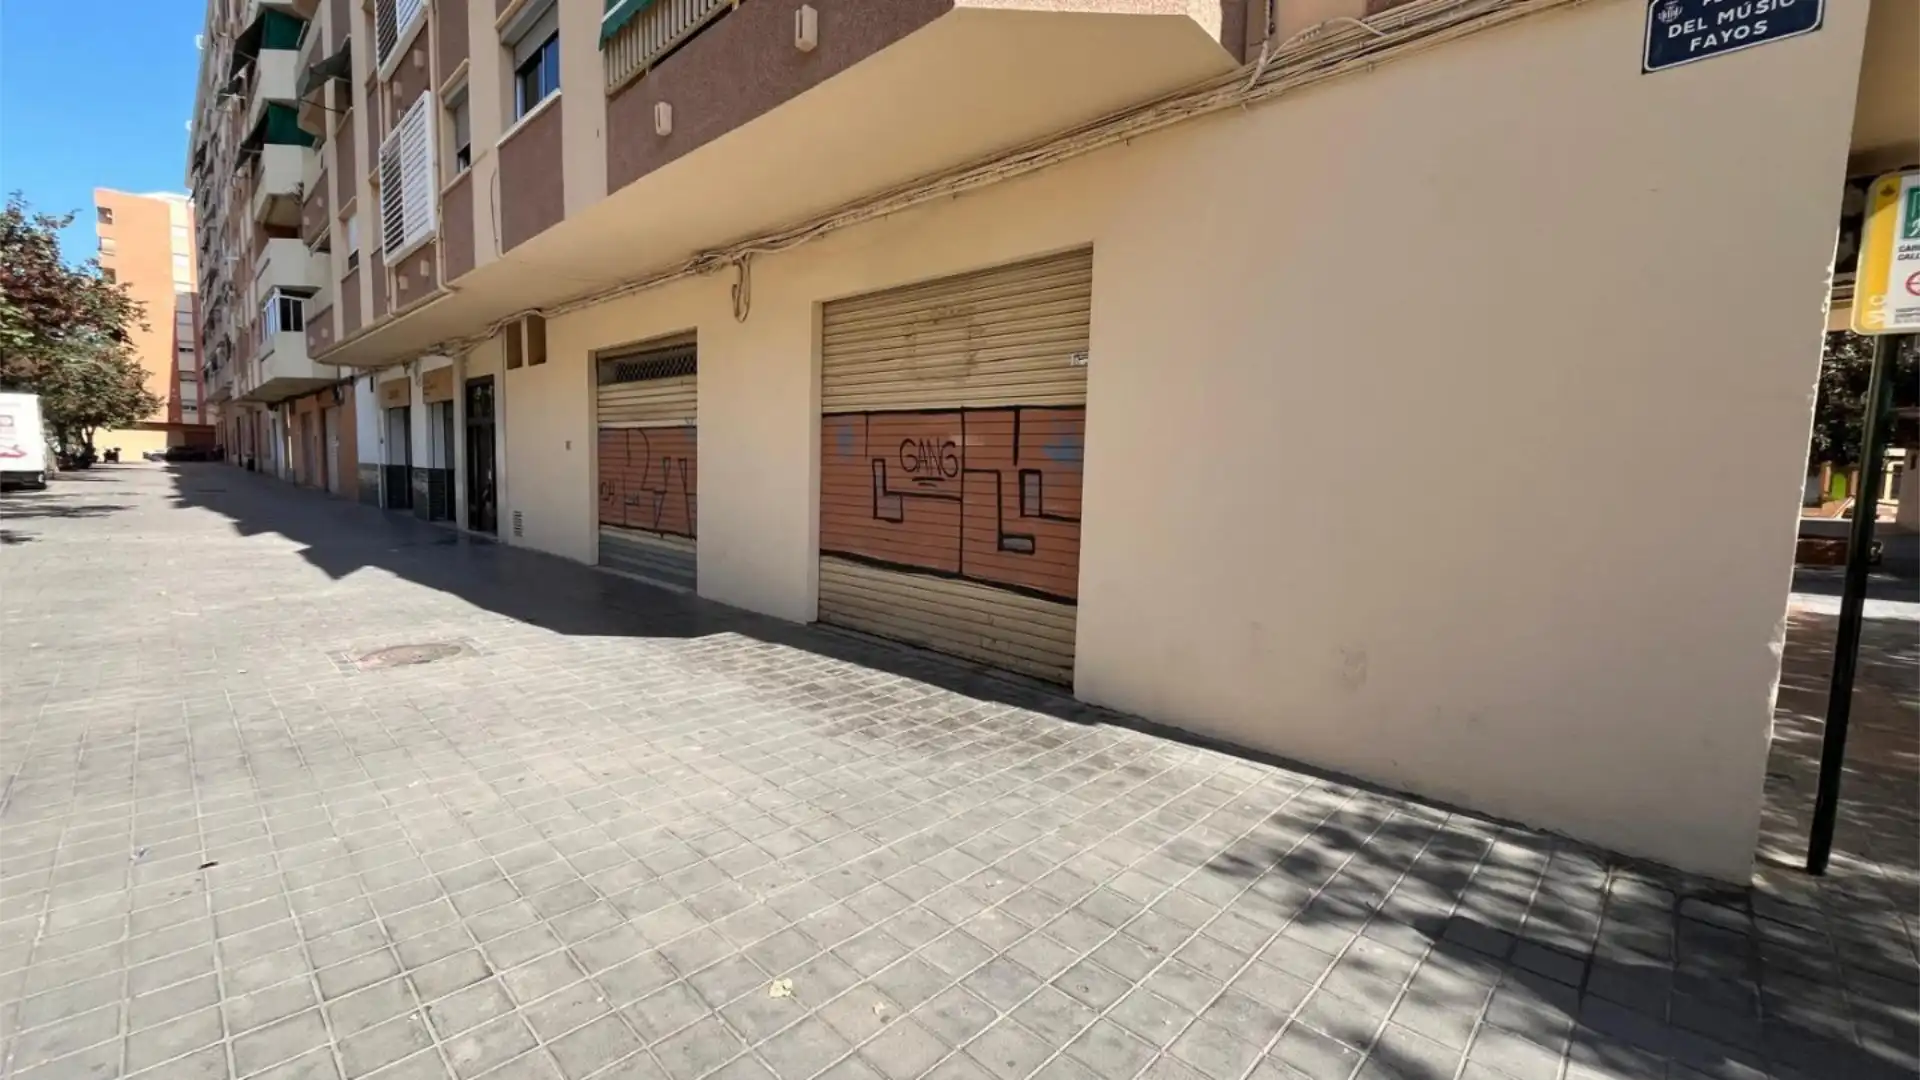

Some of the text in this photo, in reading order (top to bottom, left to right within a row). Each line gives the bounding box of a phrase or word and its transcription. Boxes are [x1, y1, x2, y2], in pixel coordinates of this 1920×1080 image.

[1668, 19, 1708, 38] DEL
[1690, 20, 1768, 52] FAYOS
[900, 437, 958, 478] GANG
